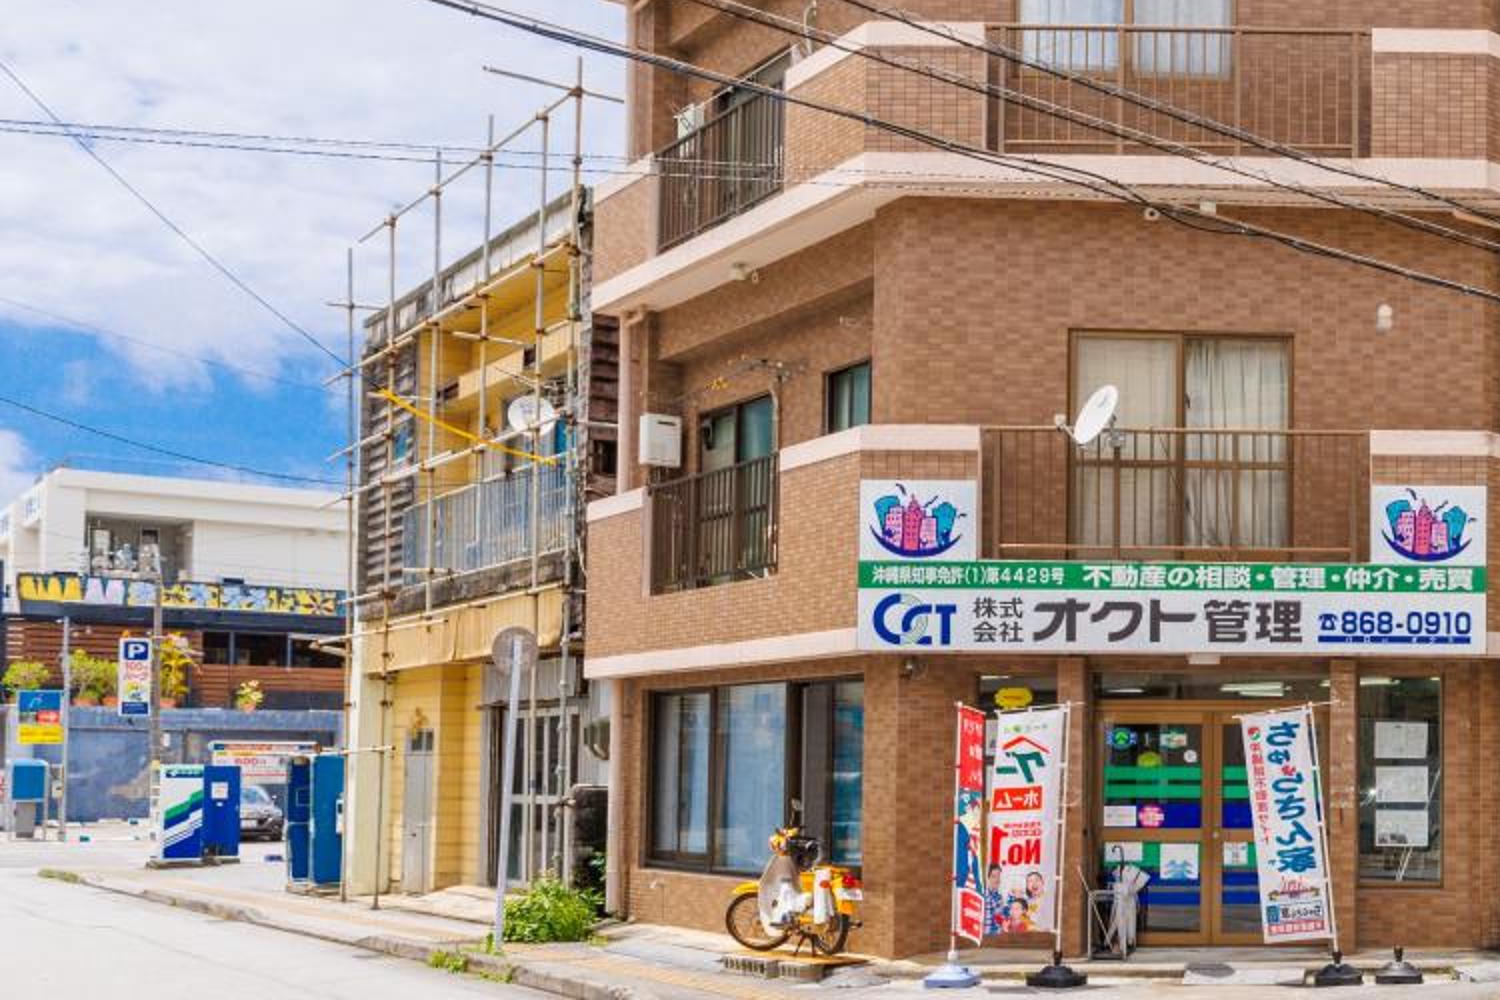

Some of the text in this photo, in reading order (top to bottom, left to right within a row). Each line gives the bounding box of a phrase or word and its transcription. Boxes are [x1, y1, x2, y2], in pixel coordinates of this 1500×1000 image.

[1082, 565, 1474, 591] 不動産の相談・管理・仲介・売買
[973, 597, 1024, 619] 株式
[1033, 598, 1303, 643] オクト管理
[973, 621, 1024, 643] 会社
[127, 643, 146, 659] P
